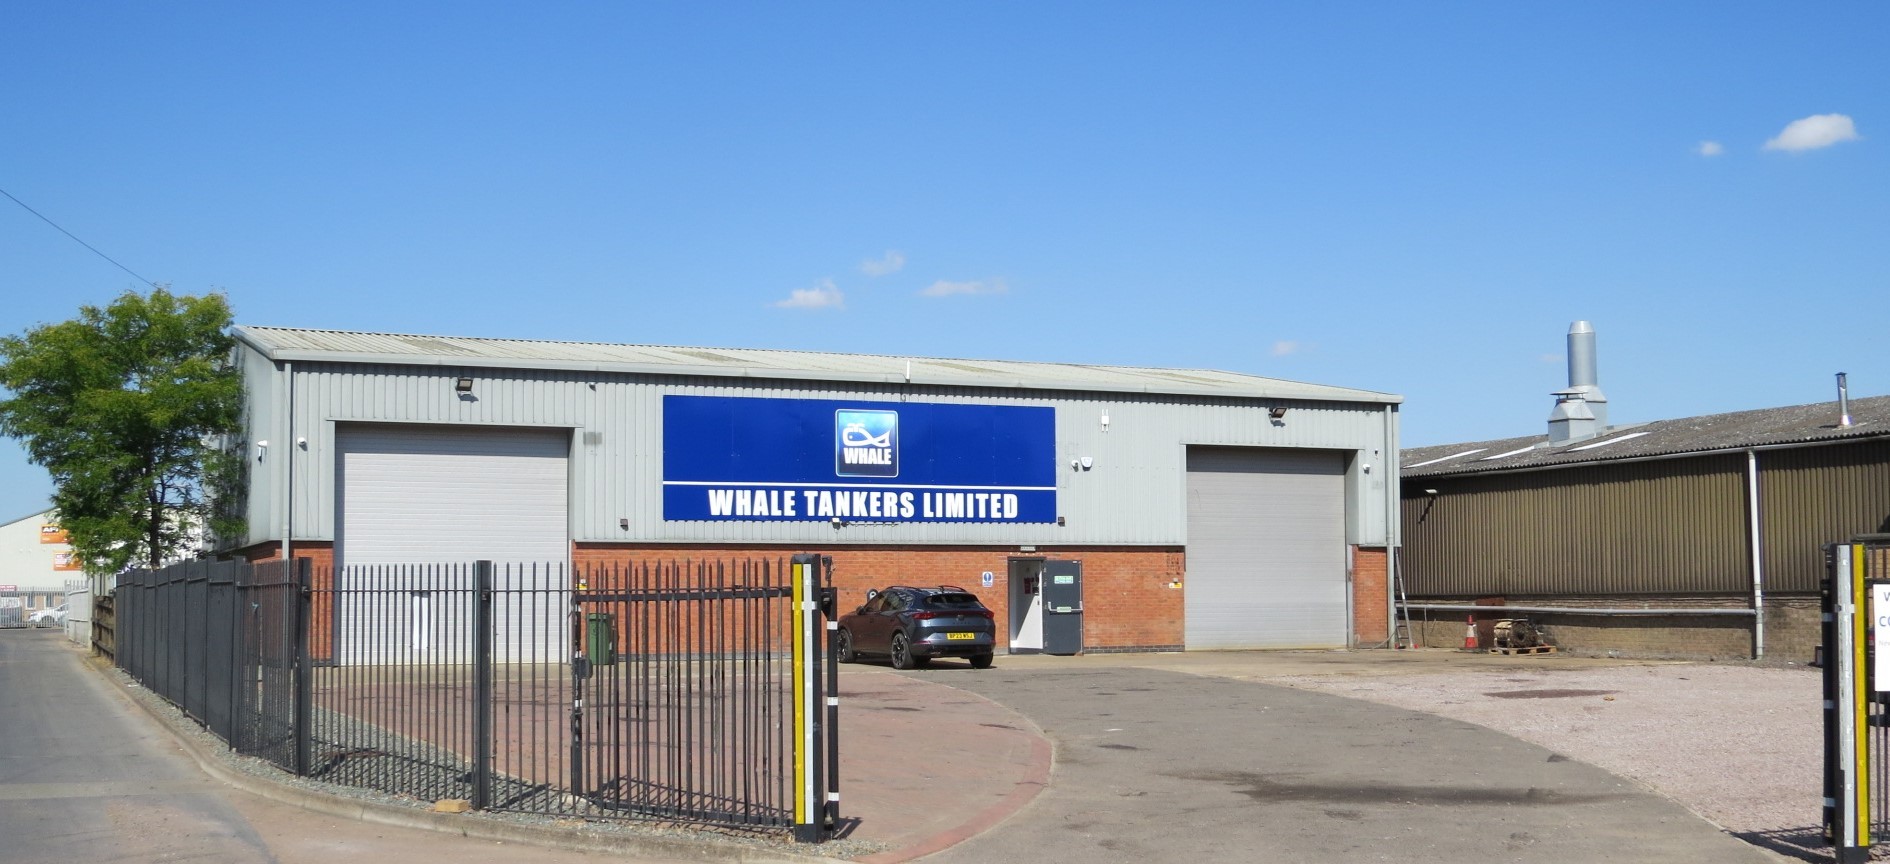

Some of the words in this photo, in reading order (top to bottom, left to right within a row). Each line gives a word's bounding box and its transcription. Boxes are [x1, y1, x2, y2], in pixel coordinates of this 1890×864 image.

[843, 447, 892, 465] WHALE
[708, 489, 796, 517] WHALE
[803, 490, 915, 518] TANKERS
[923, 492, 1018, 519] LIMITED
